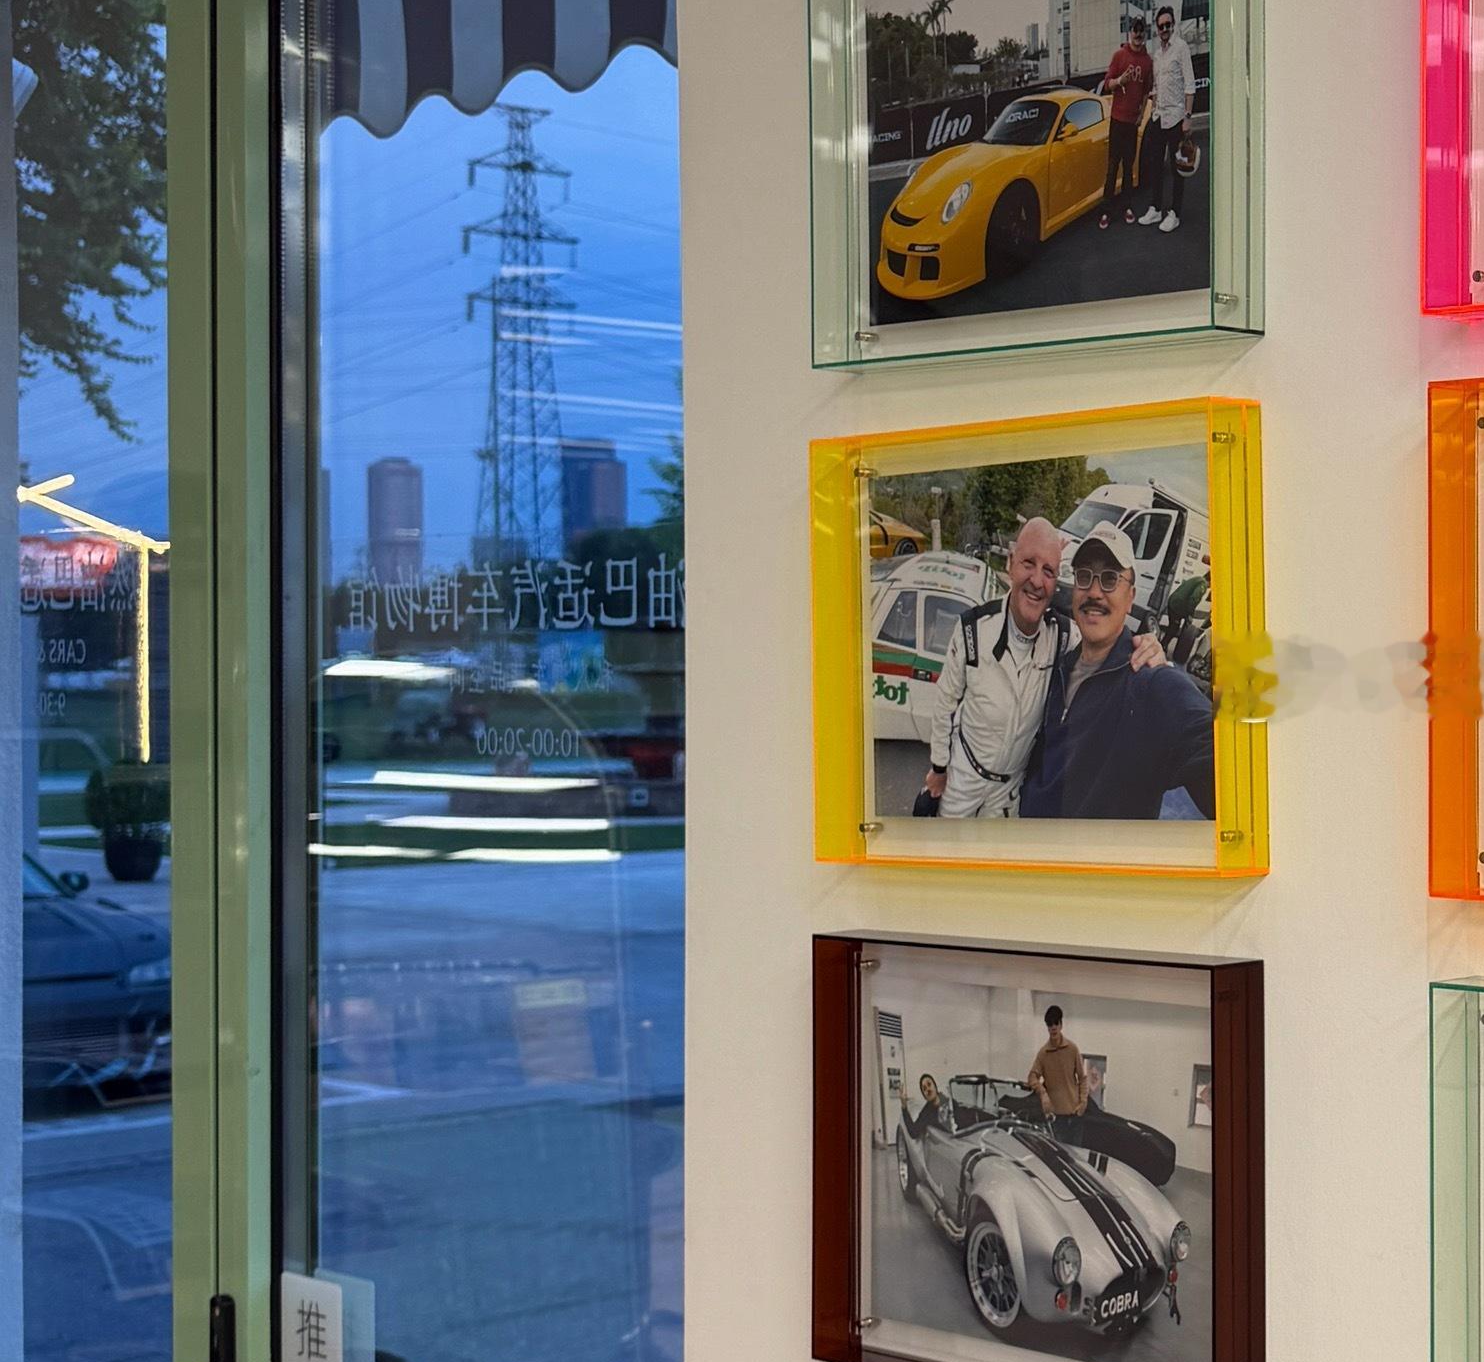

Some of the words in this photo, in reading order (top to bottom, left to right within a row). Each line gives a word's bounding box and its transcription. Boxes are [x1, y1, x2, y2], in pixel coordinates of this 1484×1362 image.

[925, 106, 973, 151] Uno
[1100, 1290, 1139, 1318] COBRA
[296, 1299, 327, 1360] 推
